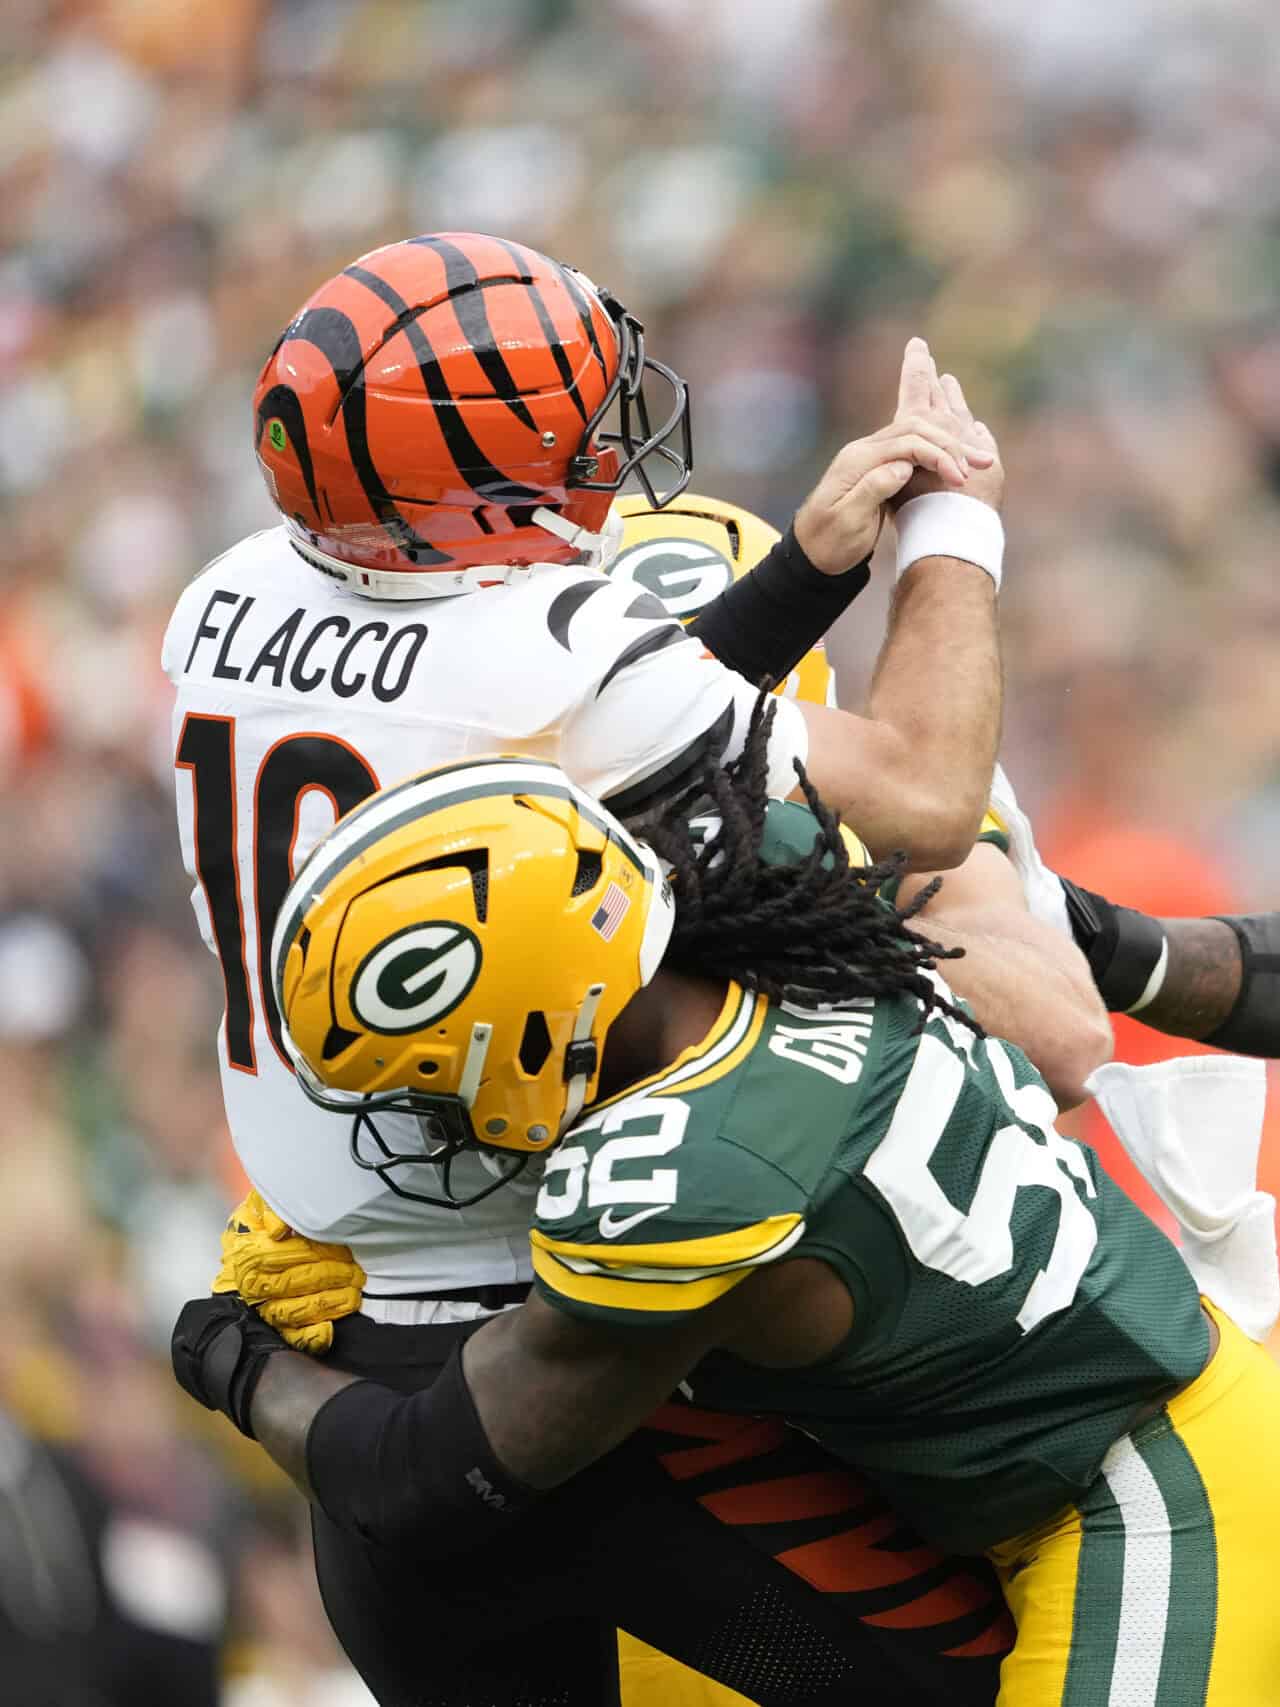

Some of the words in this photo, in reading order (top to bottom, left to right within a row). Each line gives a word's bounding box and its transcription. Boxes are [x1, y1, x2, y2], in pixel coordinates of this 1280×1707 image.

[606, 541, 729, 614] G
[184, 589, 429, 703] FLACCO
[354, 926, 477, 1030] G
[535, 1096, 691, 1220] 52
